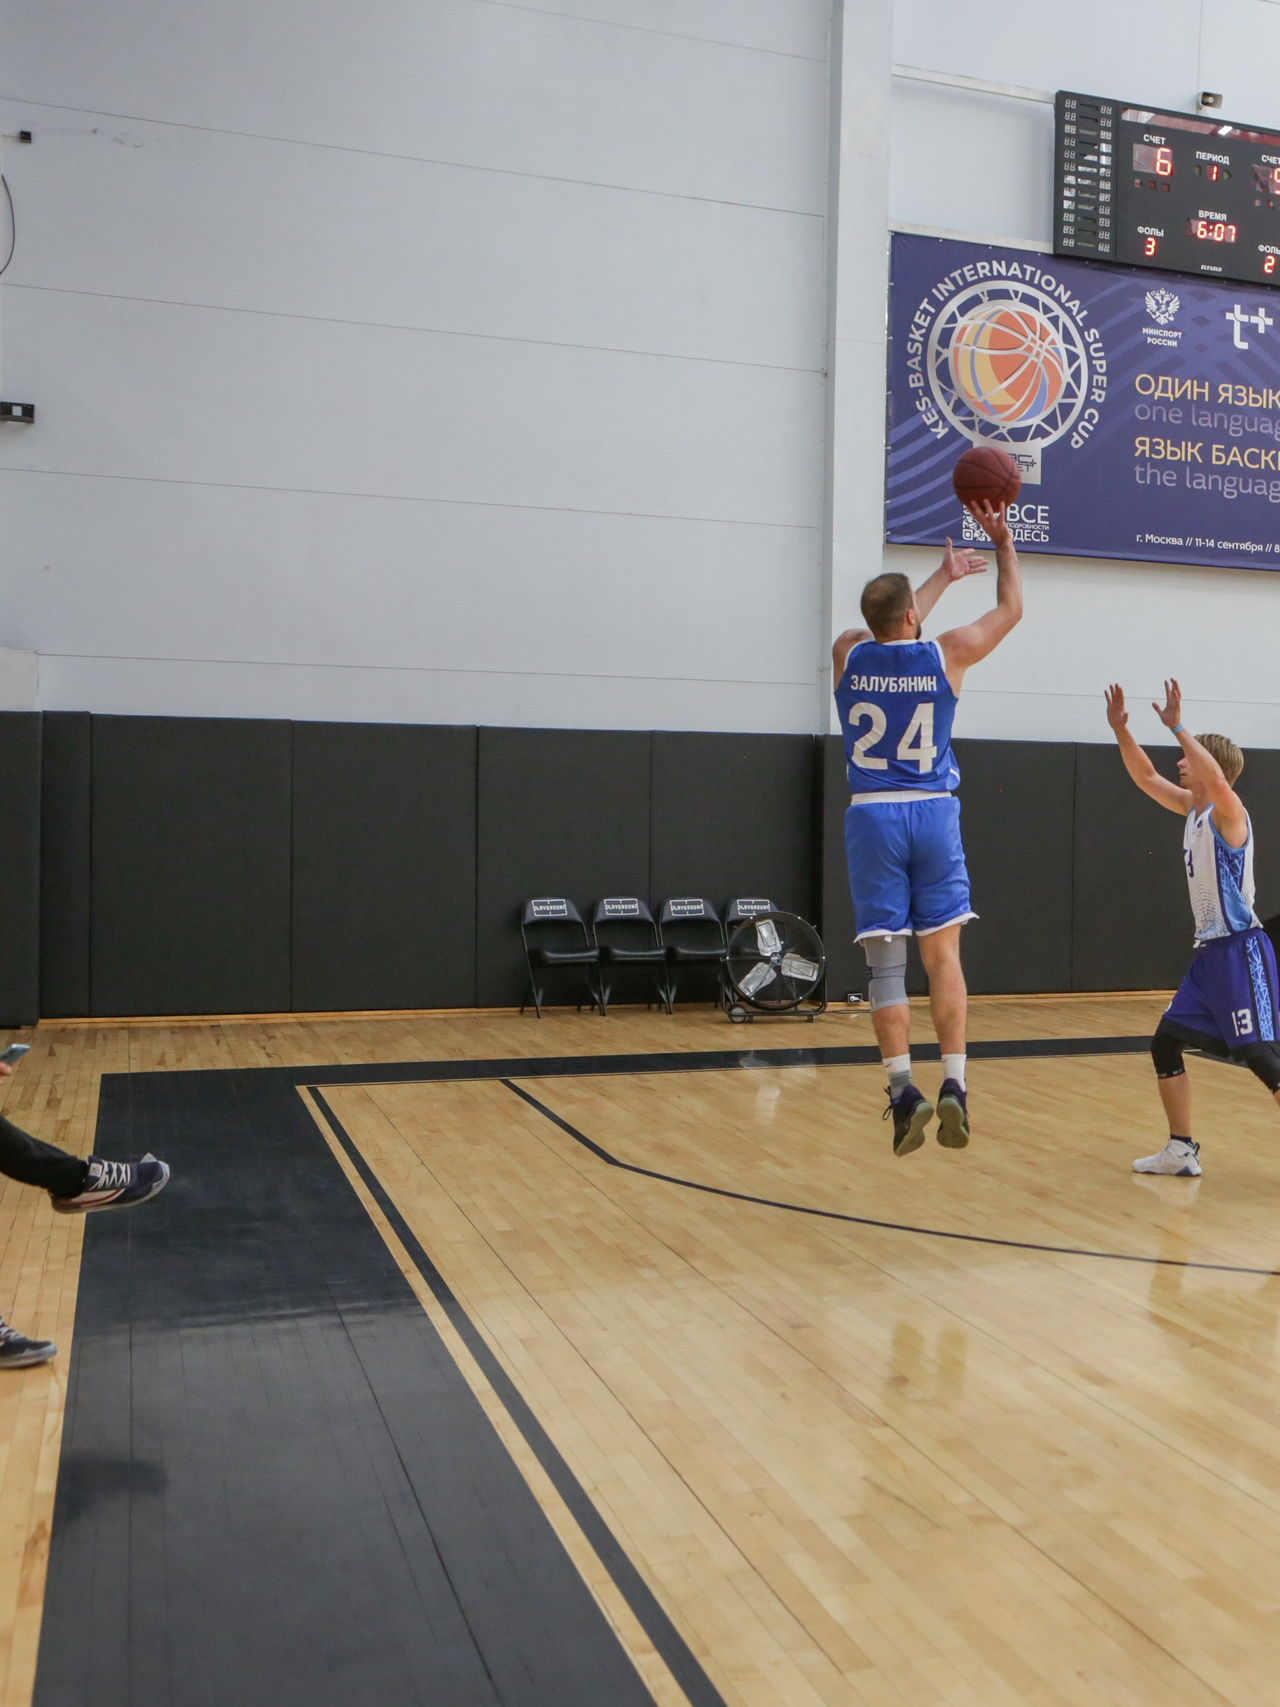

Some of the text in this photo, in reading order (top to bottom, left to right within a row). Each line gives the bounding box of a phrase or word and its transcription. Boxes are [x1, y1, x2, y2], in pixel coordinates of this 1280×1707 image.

[1143, 133, 1166, 145] СЧЕТ
[1155, 147, 1172, 176] 6
[1195, 151, 1230, 165] ПЕРИОД
[1198, 209, 1227, 221] ВРЕМЯ
[1137, 225, 1164, 237] ФОЛЫ
[1196, 220, 1237, 242] 6:07
[1144, 237, 1156, 256] 3
[1263, 255, 1276, 273] 2
[1142, 327, 1182, 339] МИНСПОРТ
[1147, 337, 1178, 347] РОССИИ
[907, 260, 1108, 450] KES-BASKET INTERNATIONAL SUPER CUP
[1135, 373, 1209, 402] ОДИН
[1135, 404, 1183, 424] one
[1134, 436, 1203, 463] ЯЗЫК
[1134, 462, 1177, 487] the
[1006, 503, 1049, 525] ВСЕ
[1136, 534, 1143, 543] г.
[1145, 534, 1184, 546] Москва
[1195, 538, 1215, 548] 11-14
[1217, 541, 1263, 554] сентября
[1274, 544, 1280, 553] 8
[850, 674, 938, 693] ЗАЛУБЯНИН
[848, 701, 938, 774] 24
